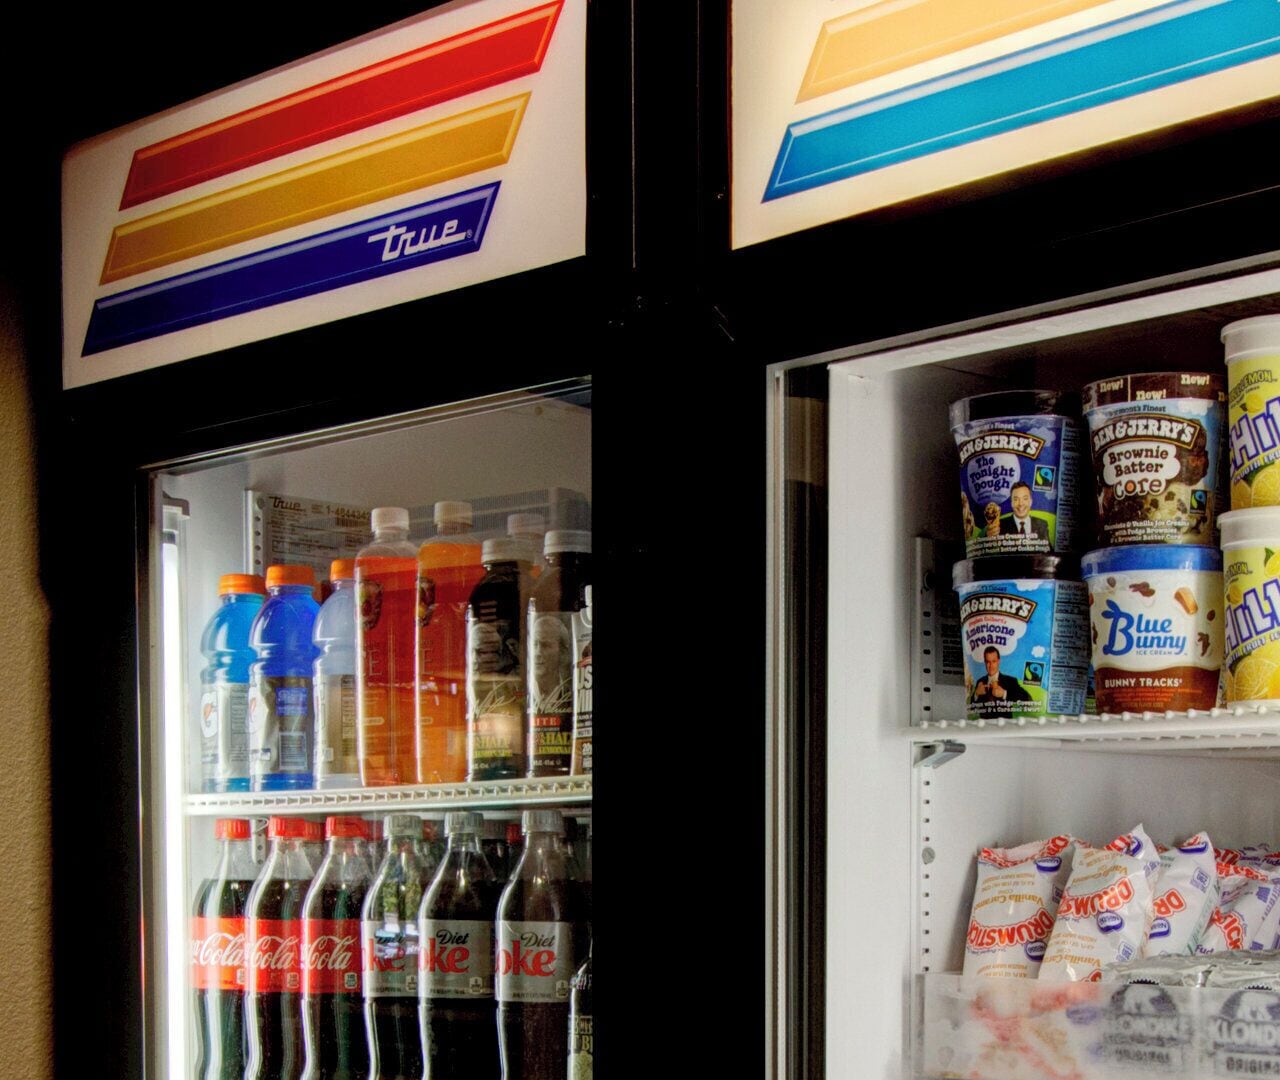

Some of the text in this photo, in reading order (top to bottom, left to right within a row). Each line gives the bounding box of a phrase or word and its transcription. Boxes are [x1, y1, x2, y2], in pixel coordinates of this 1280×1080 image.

[1142, 404, 1167, 412] Finest
[1127, 419, 1195, 443] JERRY'S
[983, 435, 1039, 455] JERRY'S
[976, 456, 994, 469] The
[1108, 446, 1169, 465] Brownie
[970, 466, 1015, 483] Tonight
[1114, 461, 1164, 477] Batter
[974, 479, 1010, 493] Dough
[979, 597, 1031, 618] JERRY'S
[966, 623, 1015, 641] Americone
[970, 634, 1007, 651] Dream
[1105, 678, 1179, 688] BUNNY TRACKS
[436, 929, 470, 945] Diet
[521, 931, 556, 947] Diet
[420, 938, 470, 973] oke
[495, 940, 556, 976] oke
